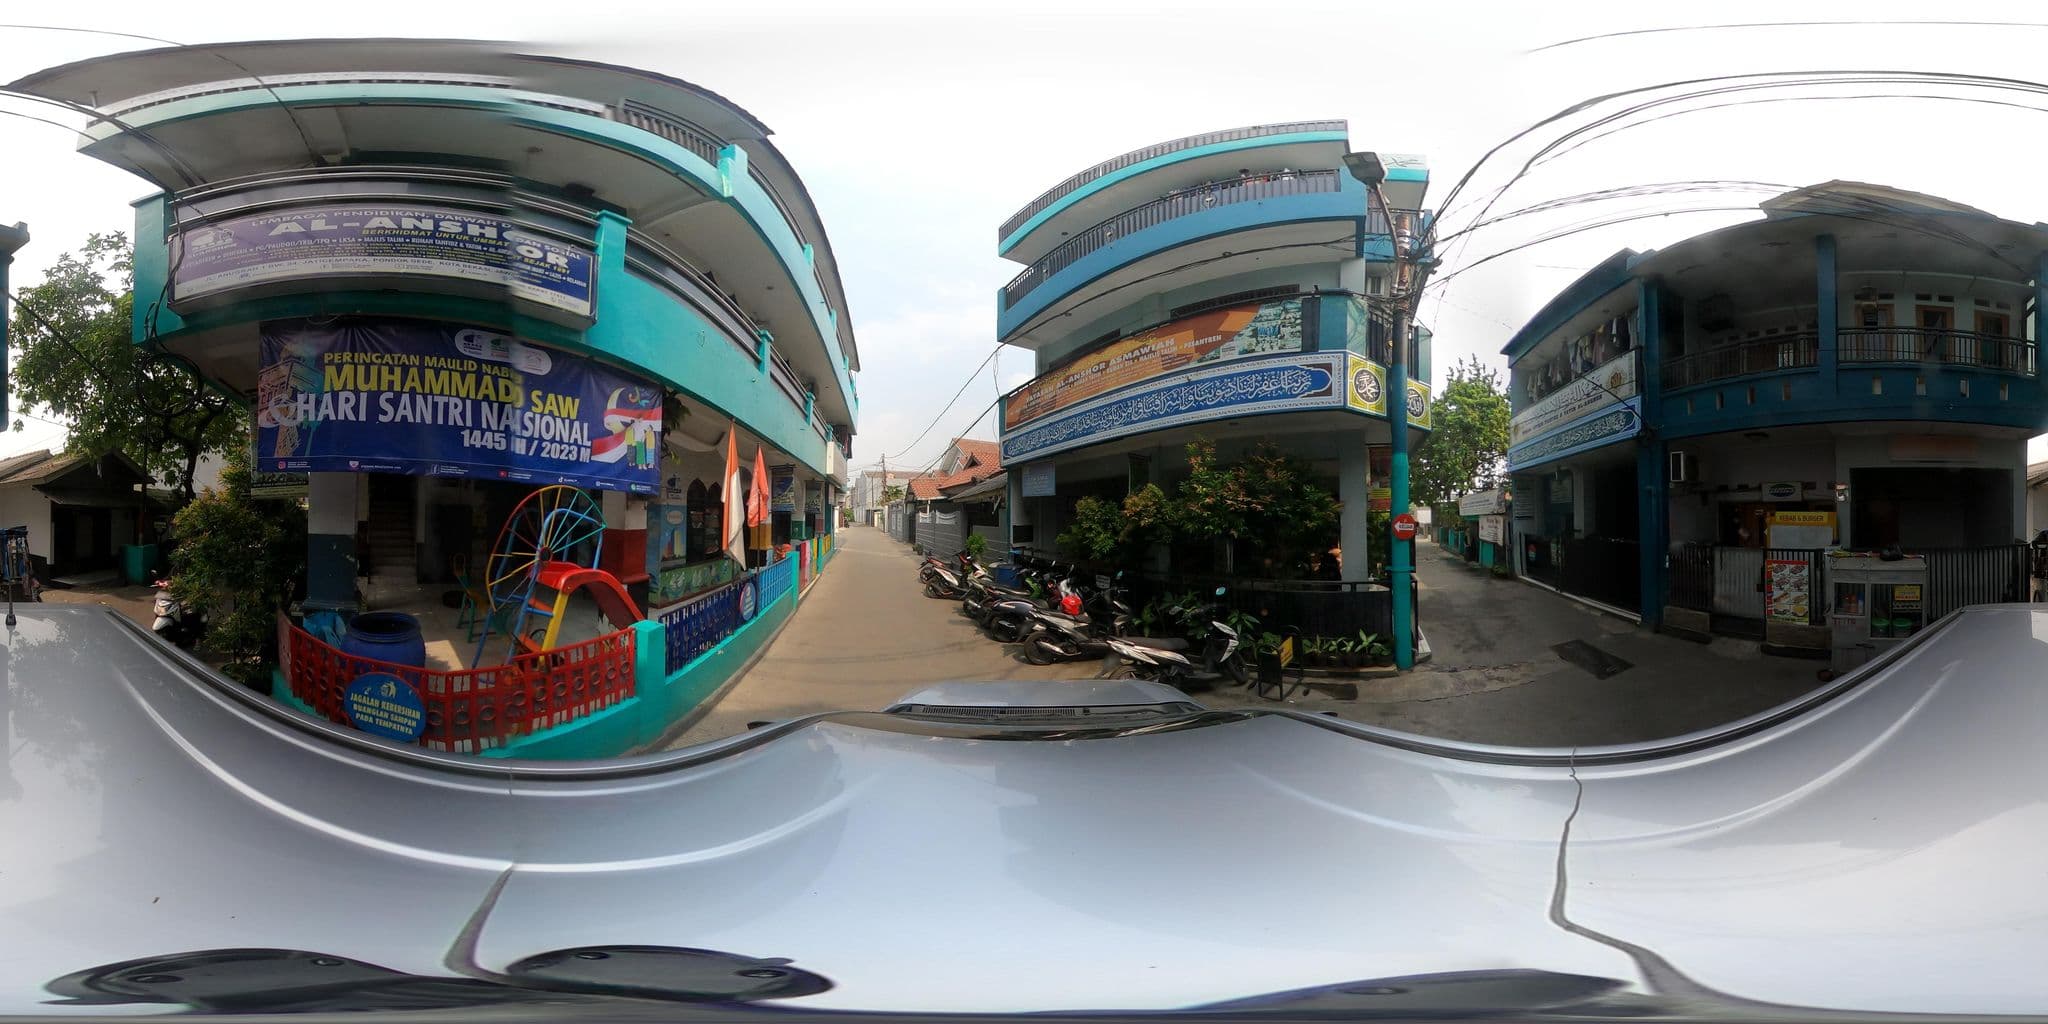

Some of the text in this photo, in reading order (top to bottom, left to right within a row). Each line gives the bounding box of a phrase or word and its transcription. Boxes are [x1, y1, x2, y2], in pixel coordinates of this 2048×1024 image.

[252, 212, 327, 226] LEMBAGA
[434, 213, 497, 226] DAKWAH
[362, 229, 432, 237] BERKHIDMAT
[435, 232, 469, 240] UNTUK
[473, 237, 510, 247] UMMAT
[324, 352, 420, 366] PERINGATAN
[424, 355, 478, 371] MAULID
[1056, 361, 1106, 389] AL-ANSHOR
[296, 391, 369, 422] HARI
[377, 391, 473, 427] SANTRI
[530, 389, 580, 420] SAW
[461, 428, 507, 451] 1445
[540, 443, 577, 461] 2023
[579, 447, 592, 463] M
[1779, 514, 1797, 522] KEBAB
[355, 712, 413, 735] PADA TEMPATNYA
[389, 713, 417, 728] SAMPAH
